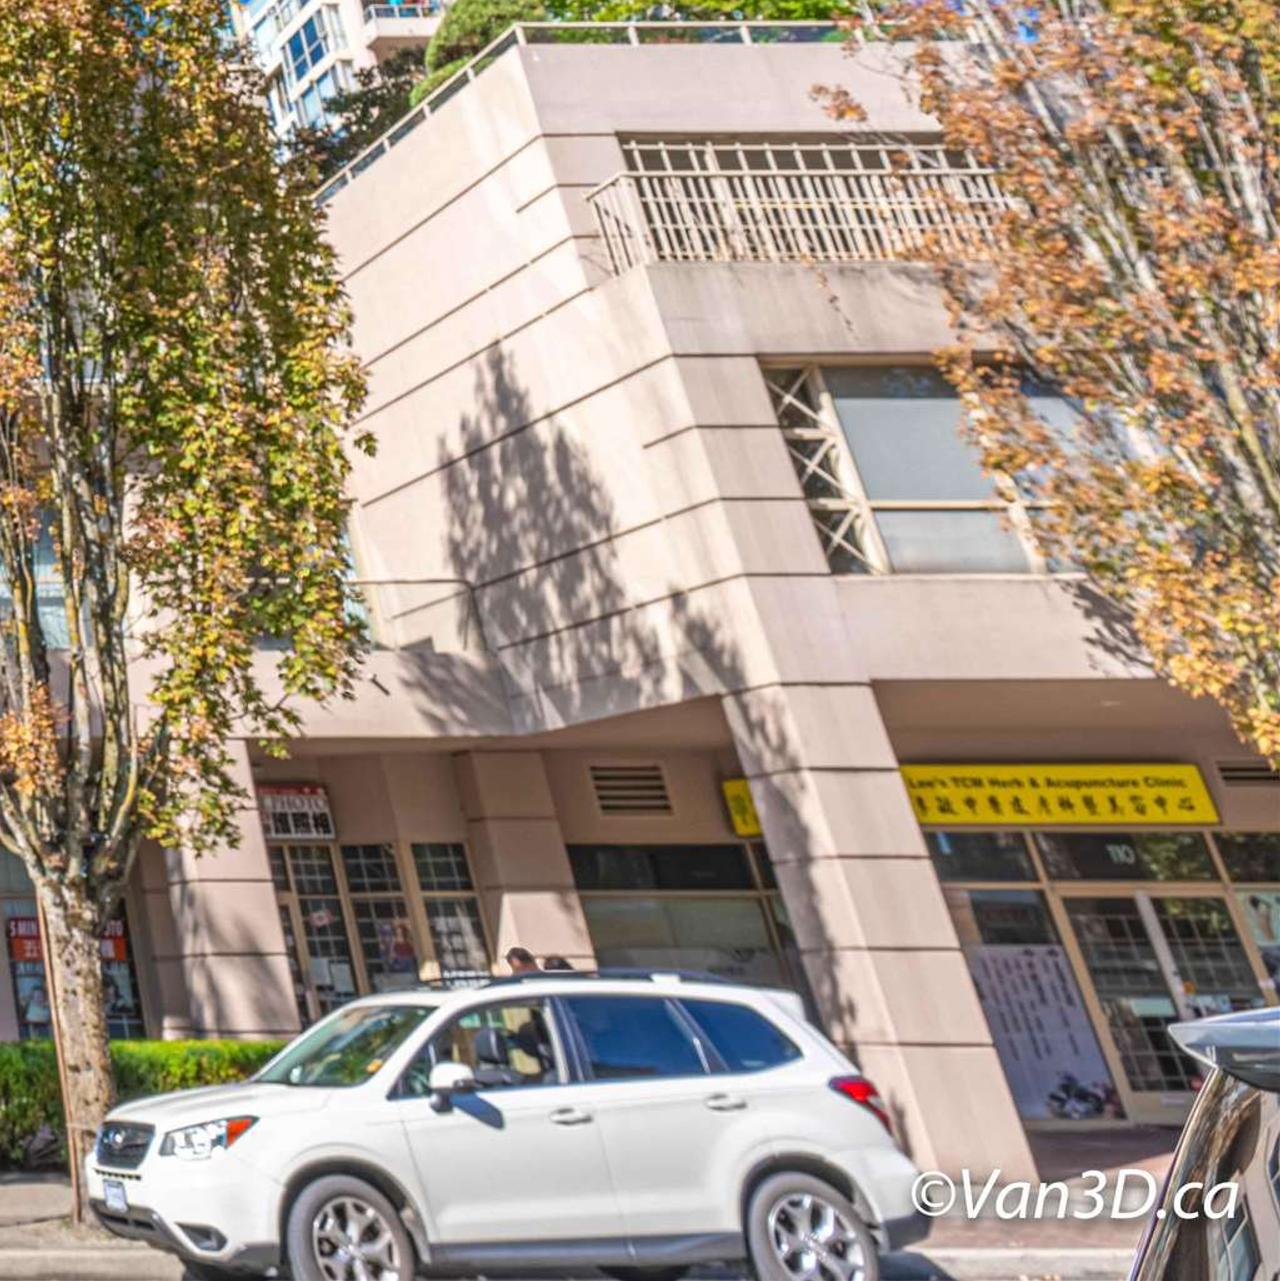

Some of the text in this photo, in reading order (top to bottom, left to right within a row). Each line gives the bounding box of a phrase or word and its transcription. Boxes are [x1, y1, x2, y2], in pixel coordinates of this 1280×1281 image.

[988, 776, 1025, 789] Herb
[1029, 776, 1040, 789] &
[1045, 776, 1139, 791] Acupuncture
[1143, 776, 1187, 789] Clinic
[270, 795, 326, 811] PHOTO
